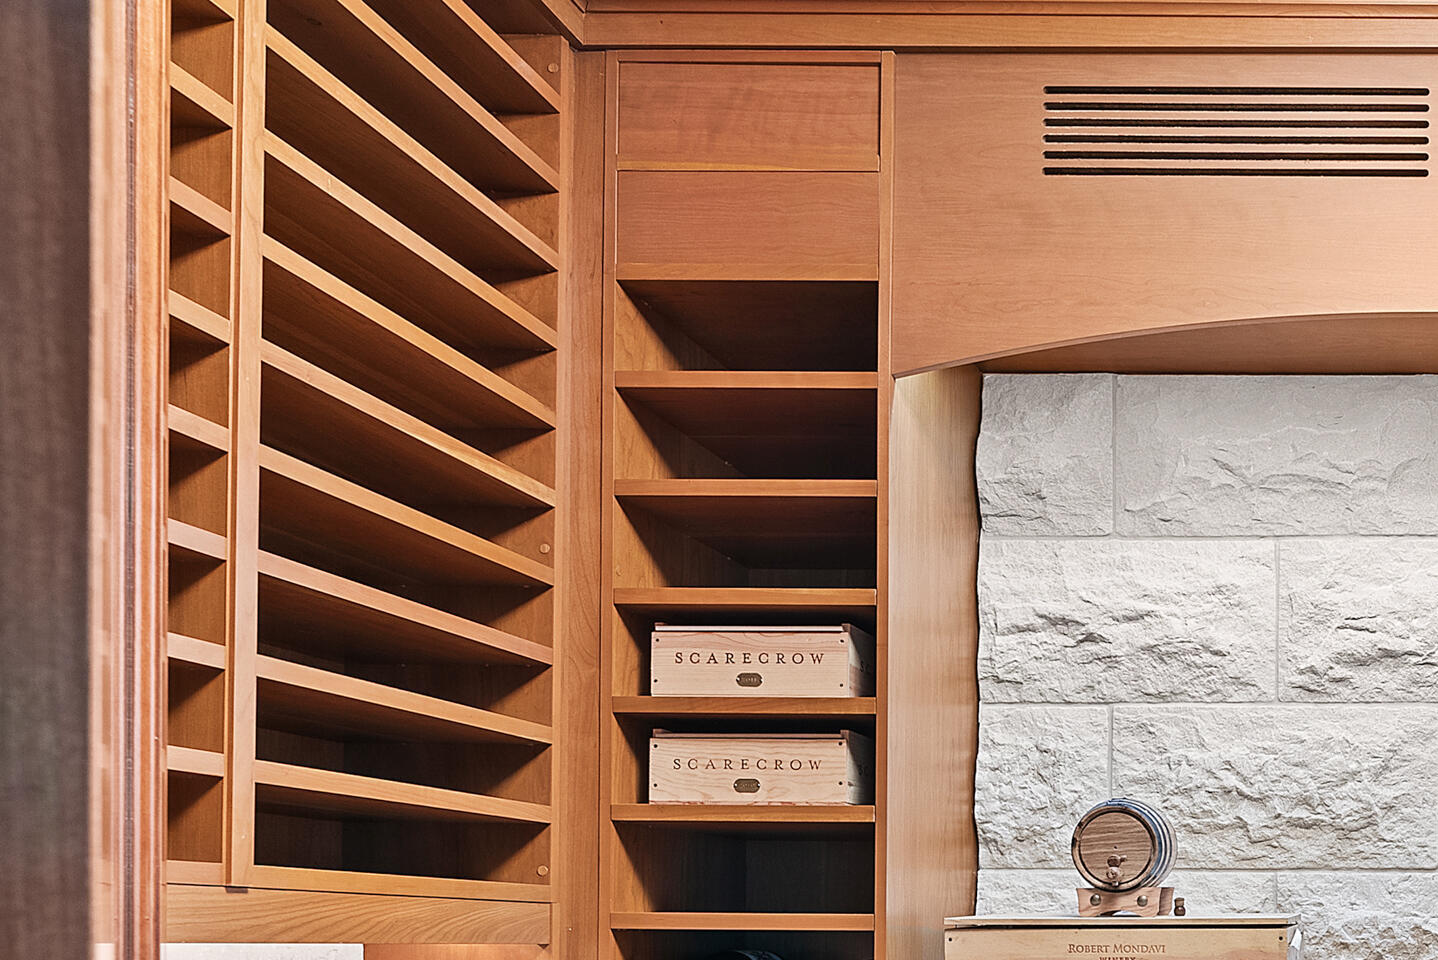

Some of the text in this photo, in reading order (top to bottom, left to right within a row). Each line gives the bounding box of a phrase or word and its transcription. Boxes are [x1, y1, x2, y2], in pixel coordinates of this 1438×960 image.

[674, 652, 825, 665] SCARECROW
[672, 758, 823, 771] SCARECROW
[1067, 943, 1166, 954] ROBERT MONDAVI
